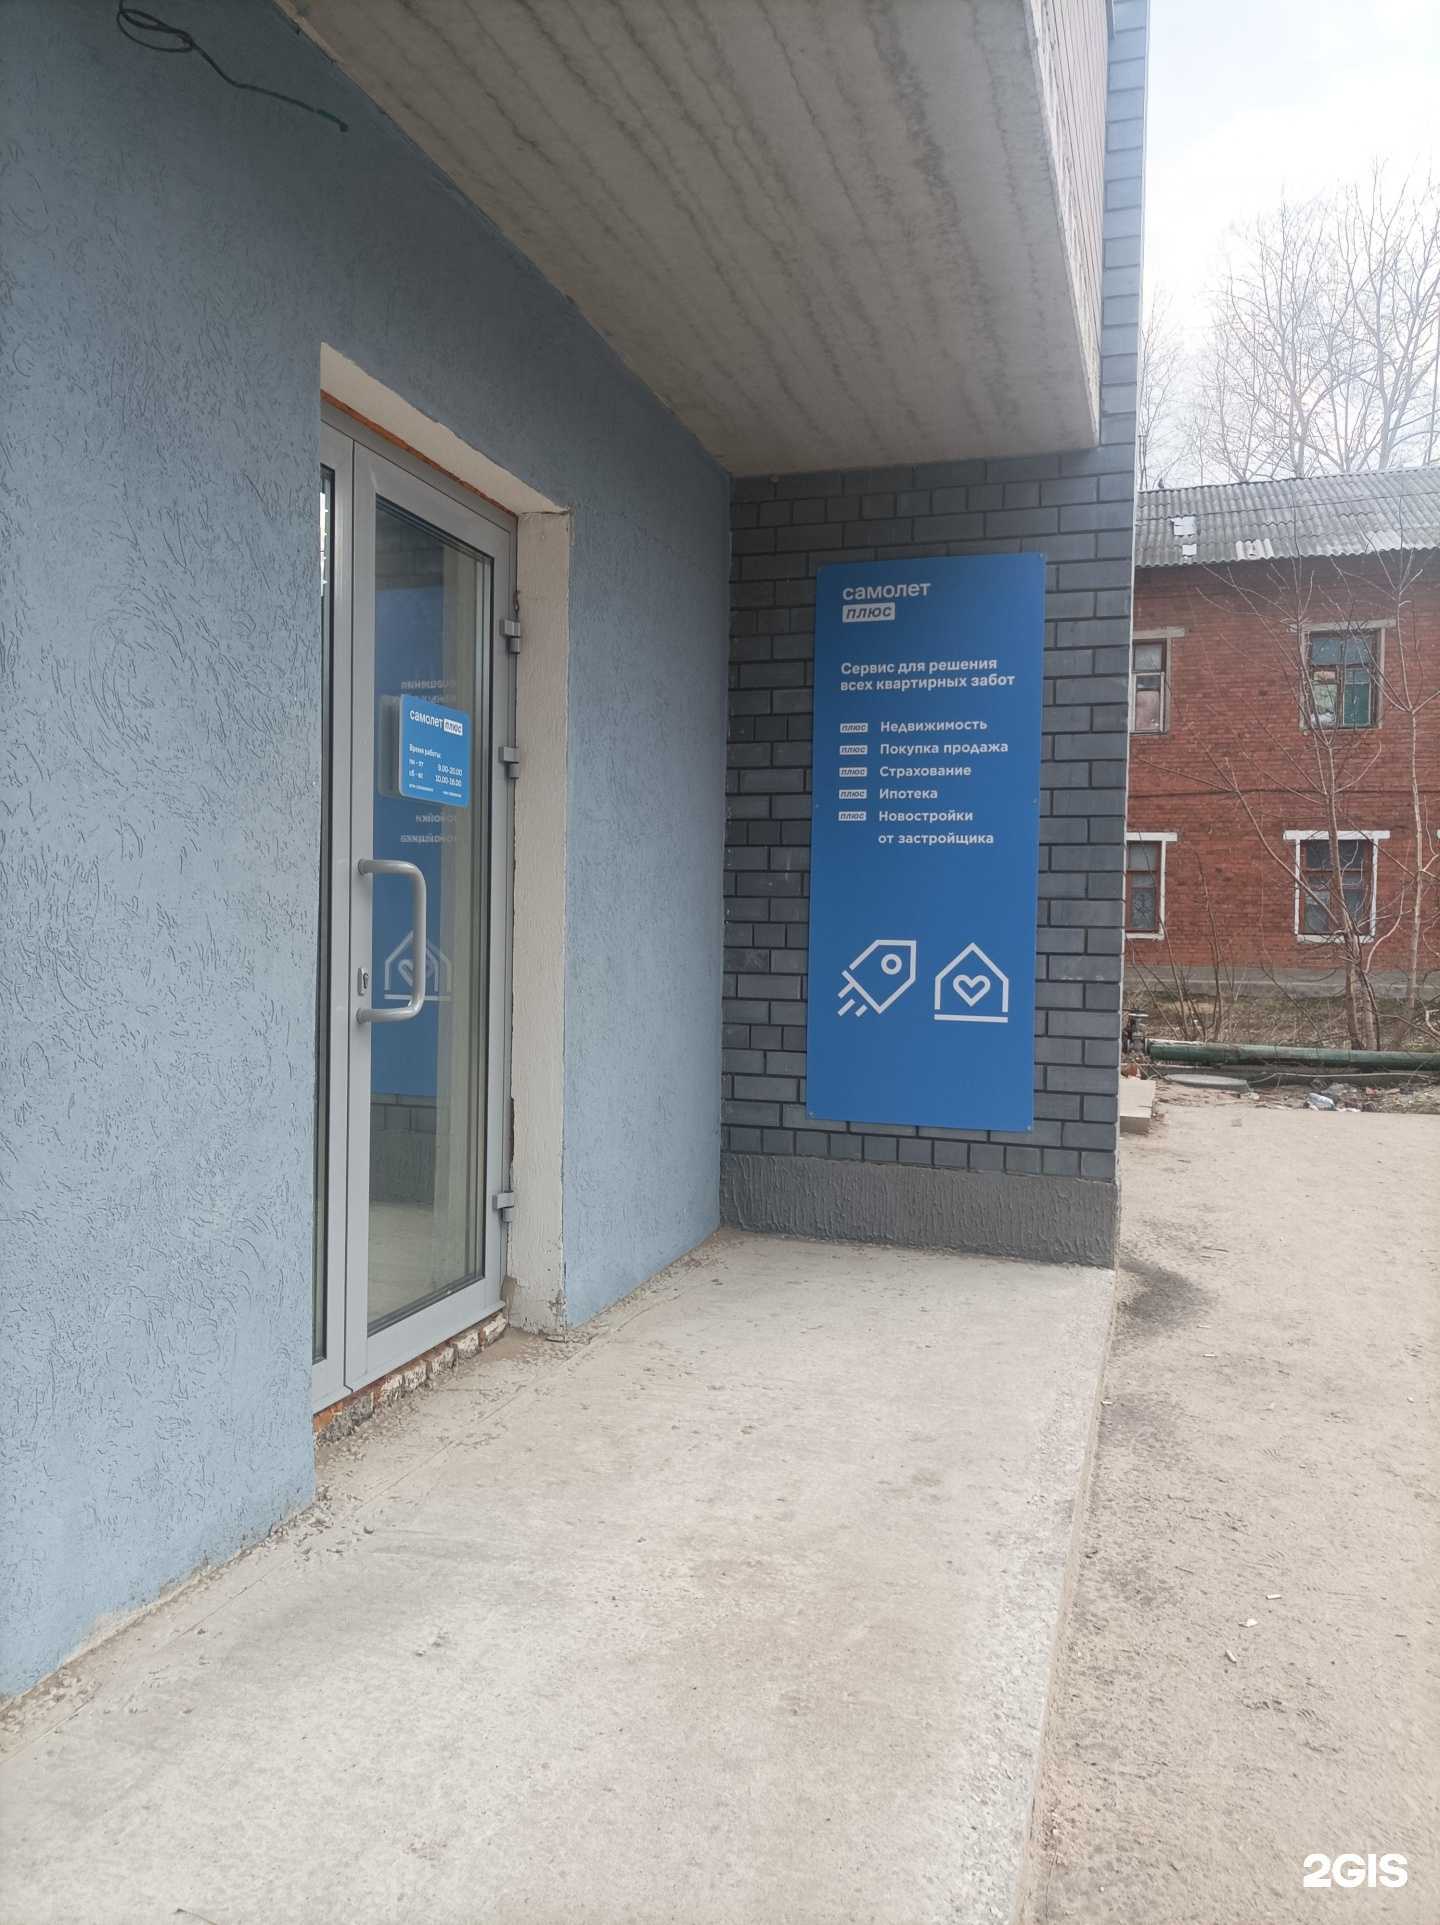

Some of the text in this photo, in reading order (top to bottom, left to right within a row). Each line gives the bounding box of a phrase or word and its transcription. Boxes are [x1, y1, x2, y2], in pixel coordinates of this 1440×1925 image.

[842, 582, 931, 601] самолет
[845, 606, 893, 621] плюс
[841, 659, 998, 677] Сервис для решения
[840, 673, 1015, 692] всех квартирных забот
[409, 709, 463, 734] самолет плюс
[841, 720, 988, 733] плюс Недвижимость
[841, 742, 1009, 756] плюс Покупка продажа
[840, 766, 972, 779] плюс Страхование
[840, 789, 939, 800] плюс Ипотека
[839, 809, 974, 823] плюс Новостройки
[878, 831, 995, 846] от застройщика
